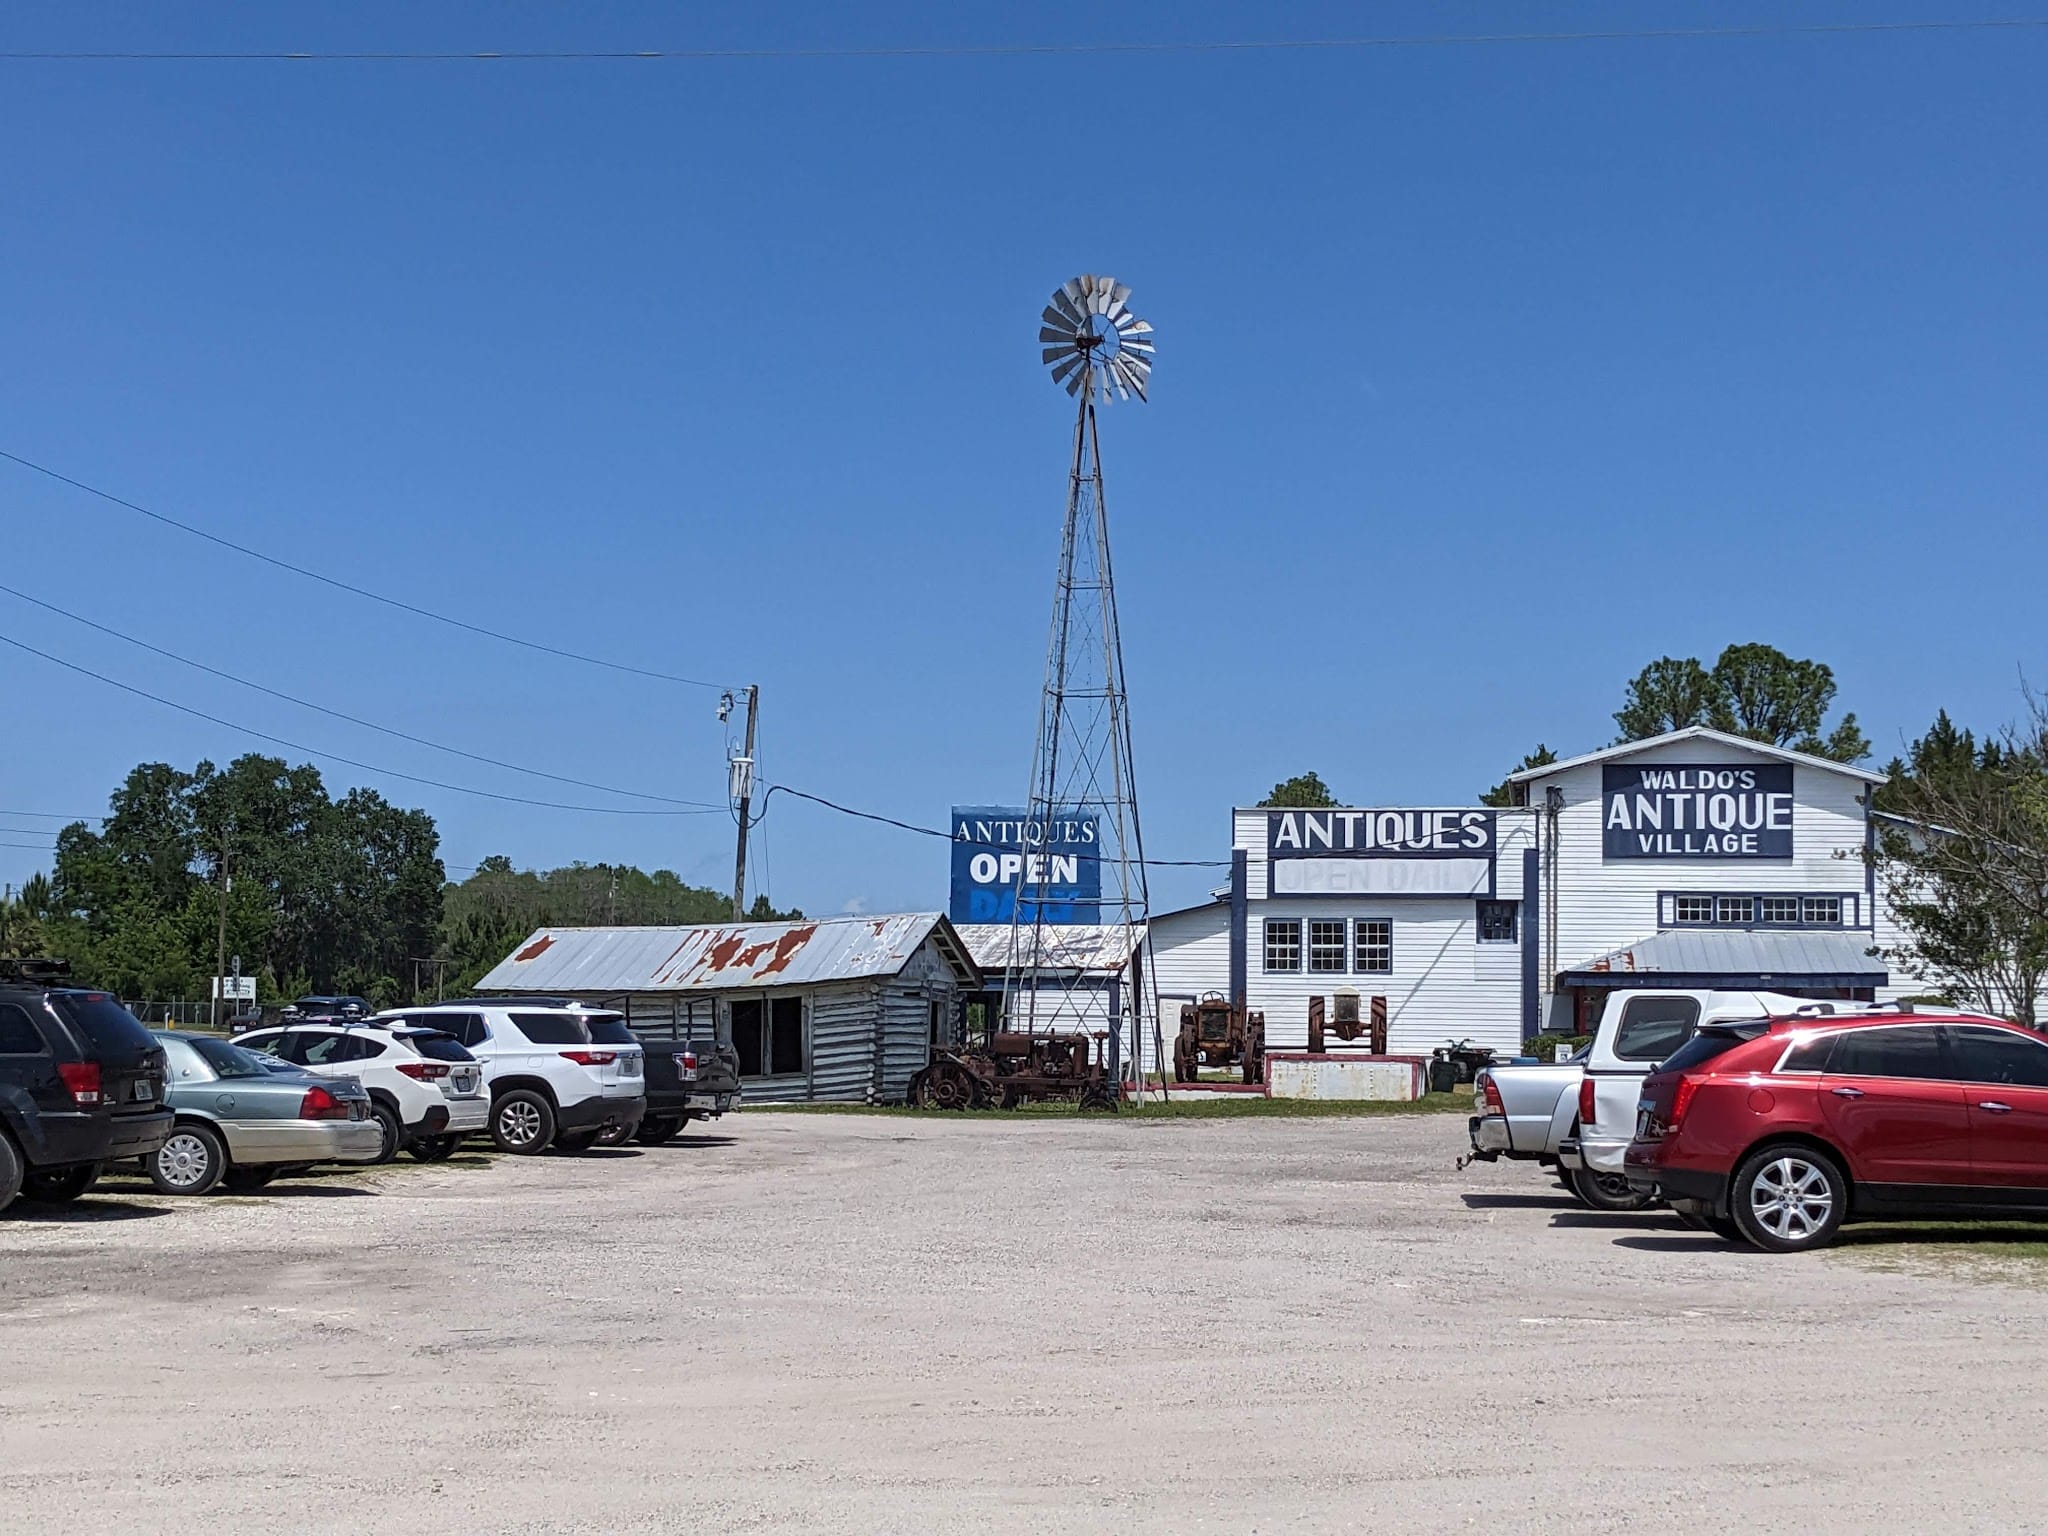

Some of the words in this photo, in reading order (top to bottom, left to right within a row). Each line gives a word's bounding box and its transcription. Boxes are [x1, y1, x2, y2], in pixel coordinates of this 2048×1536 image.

[1640, 770, 1756, 790] WALDO'S
[1607, 793, 1793, 832] ANTIQUE
[954, 820, 1095, 845] ANTIQUES
[1275, 812, 1489, 850] ANTIQUES
[1639, 833, 1758, 853] VILLAGE
[970, 853, 1078, 884] OPEN
